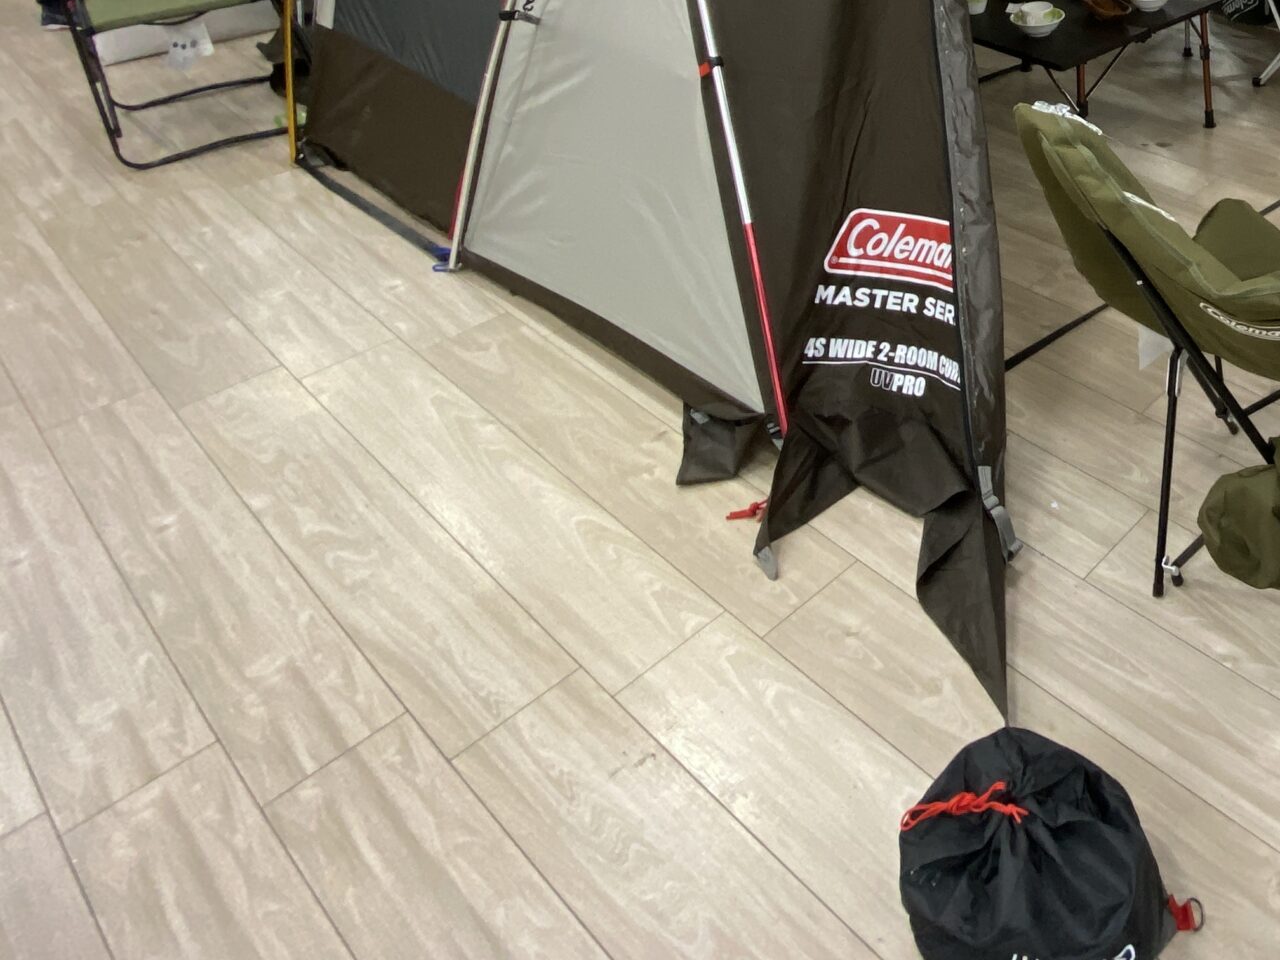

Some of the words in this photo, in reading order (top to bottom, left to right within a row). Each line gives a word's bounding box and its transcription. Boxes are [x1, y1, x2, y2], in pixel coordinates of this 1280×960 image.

[814, 285, 920, 314] MASTER
[922, 296, 956, 326] SER
[804, 337, 827, 358] 4S
[828, 338, 877, 359] WIDE
[877, 341, 939, 371] 2-ROOM
